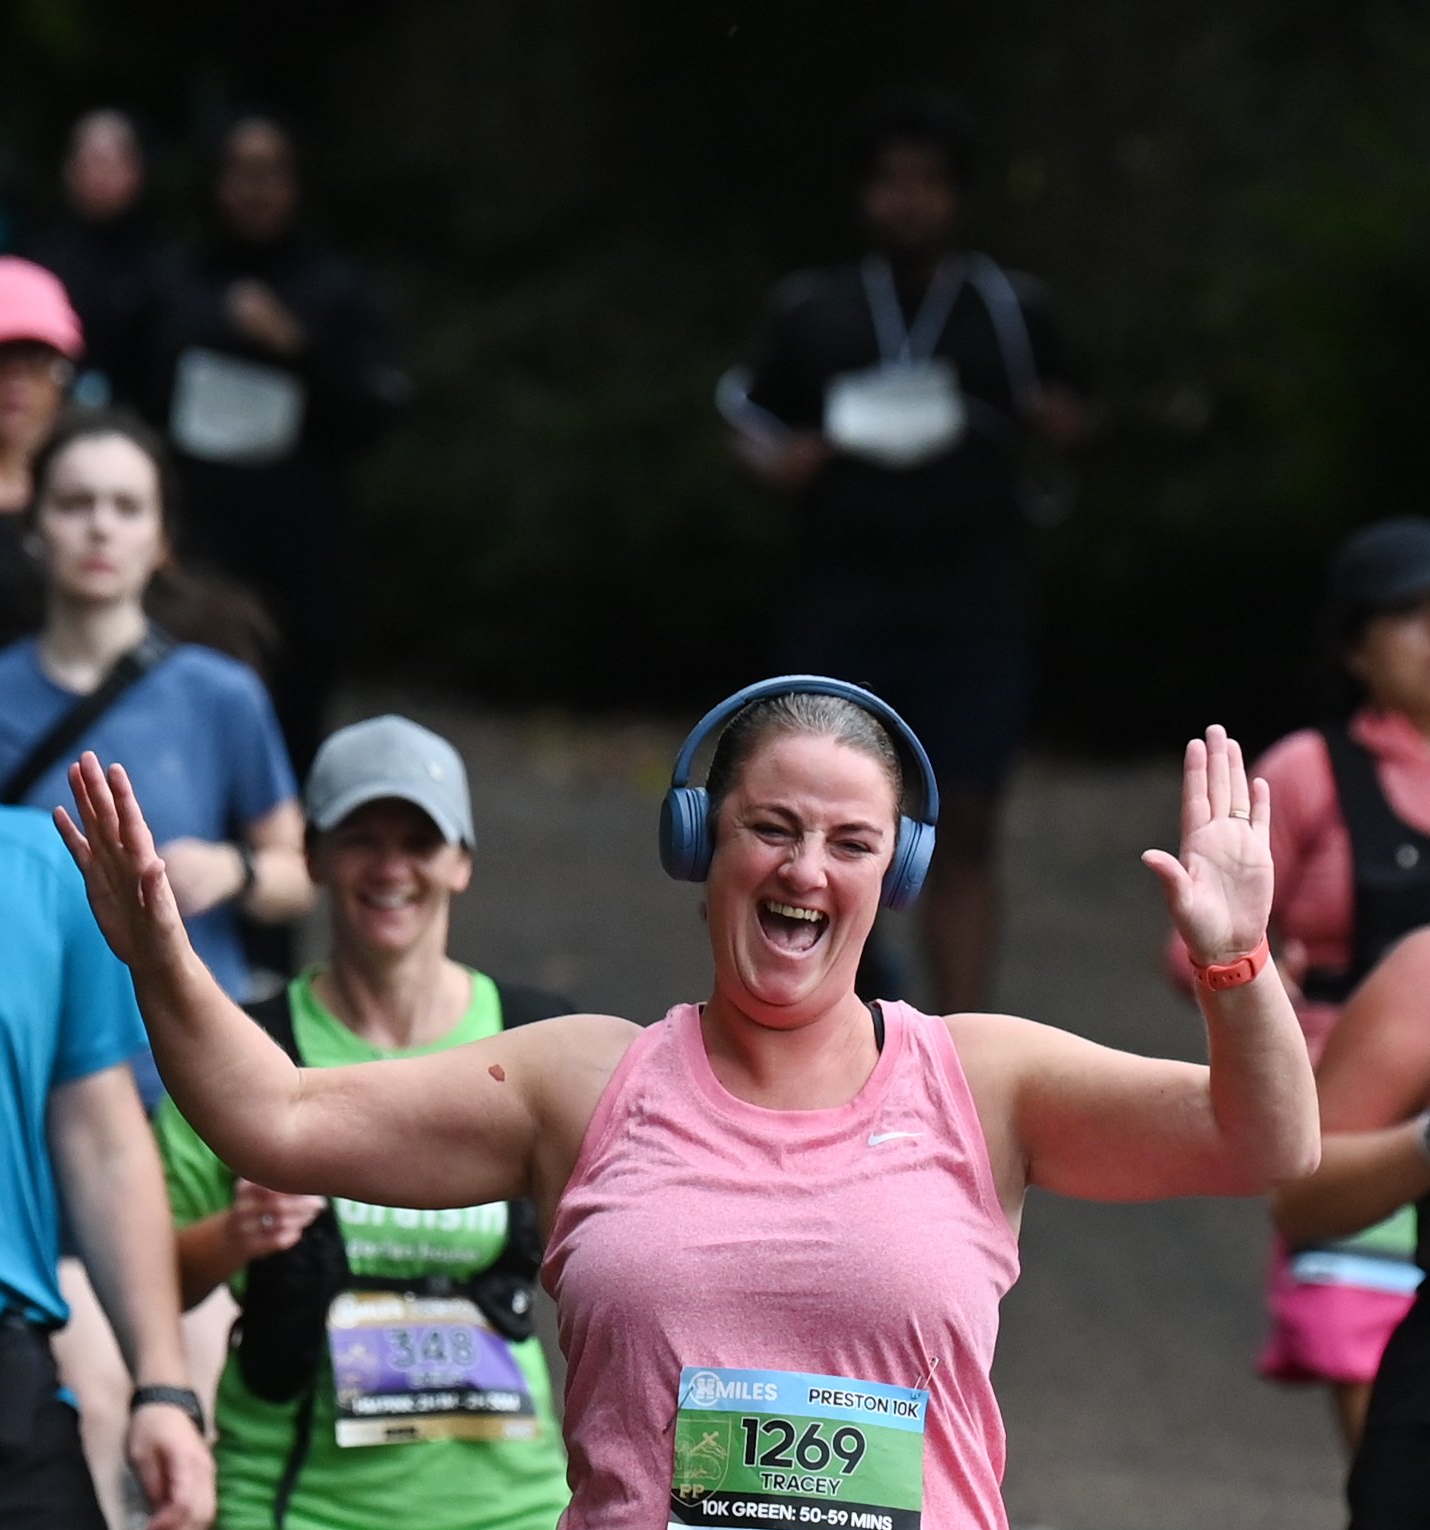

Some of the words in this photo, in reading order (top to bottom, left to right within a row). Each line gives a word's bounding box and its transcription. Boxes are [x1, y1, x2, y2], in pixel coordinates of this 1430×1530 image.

[715, 1380, 779, 1402] MILES
[808, 1388, 889, 1413] PRESTON
[892, 1400, 919, 1418] 10K
[741, 1417, 866, 1474] 1269
[761, 1473, 841, 1495] TRACEY
[701, 1500, 730, 1516] 10K
[731, 1501, 796, 1521] GREEN:
[799, 1506, 849, 1526] 50-59
